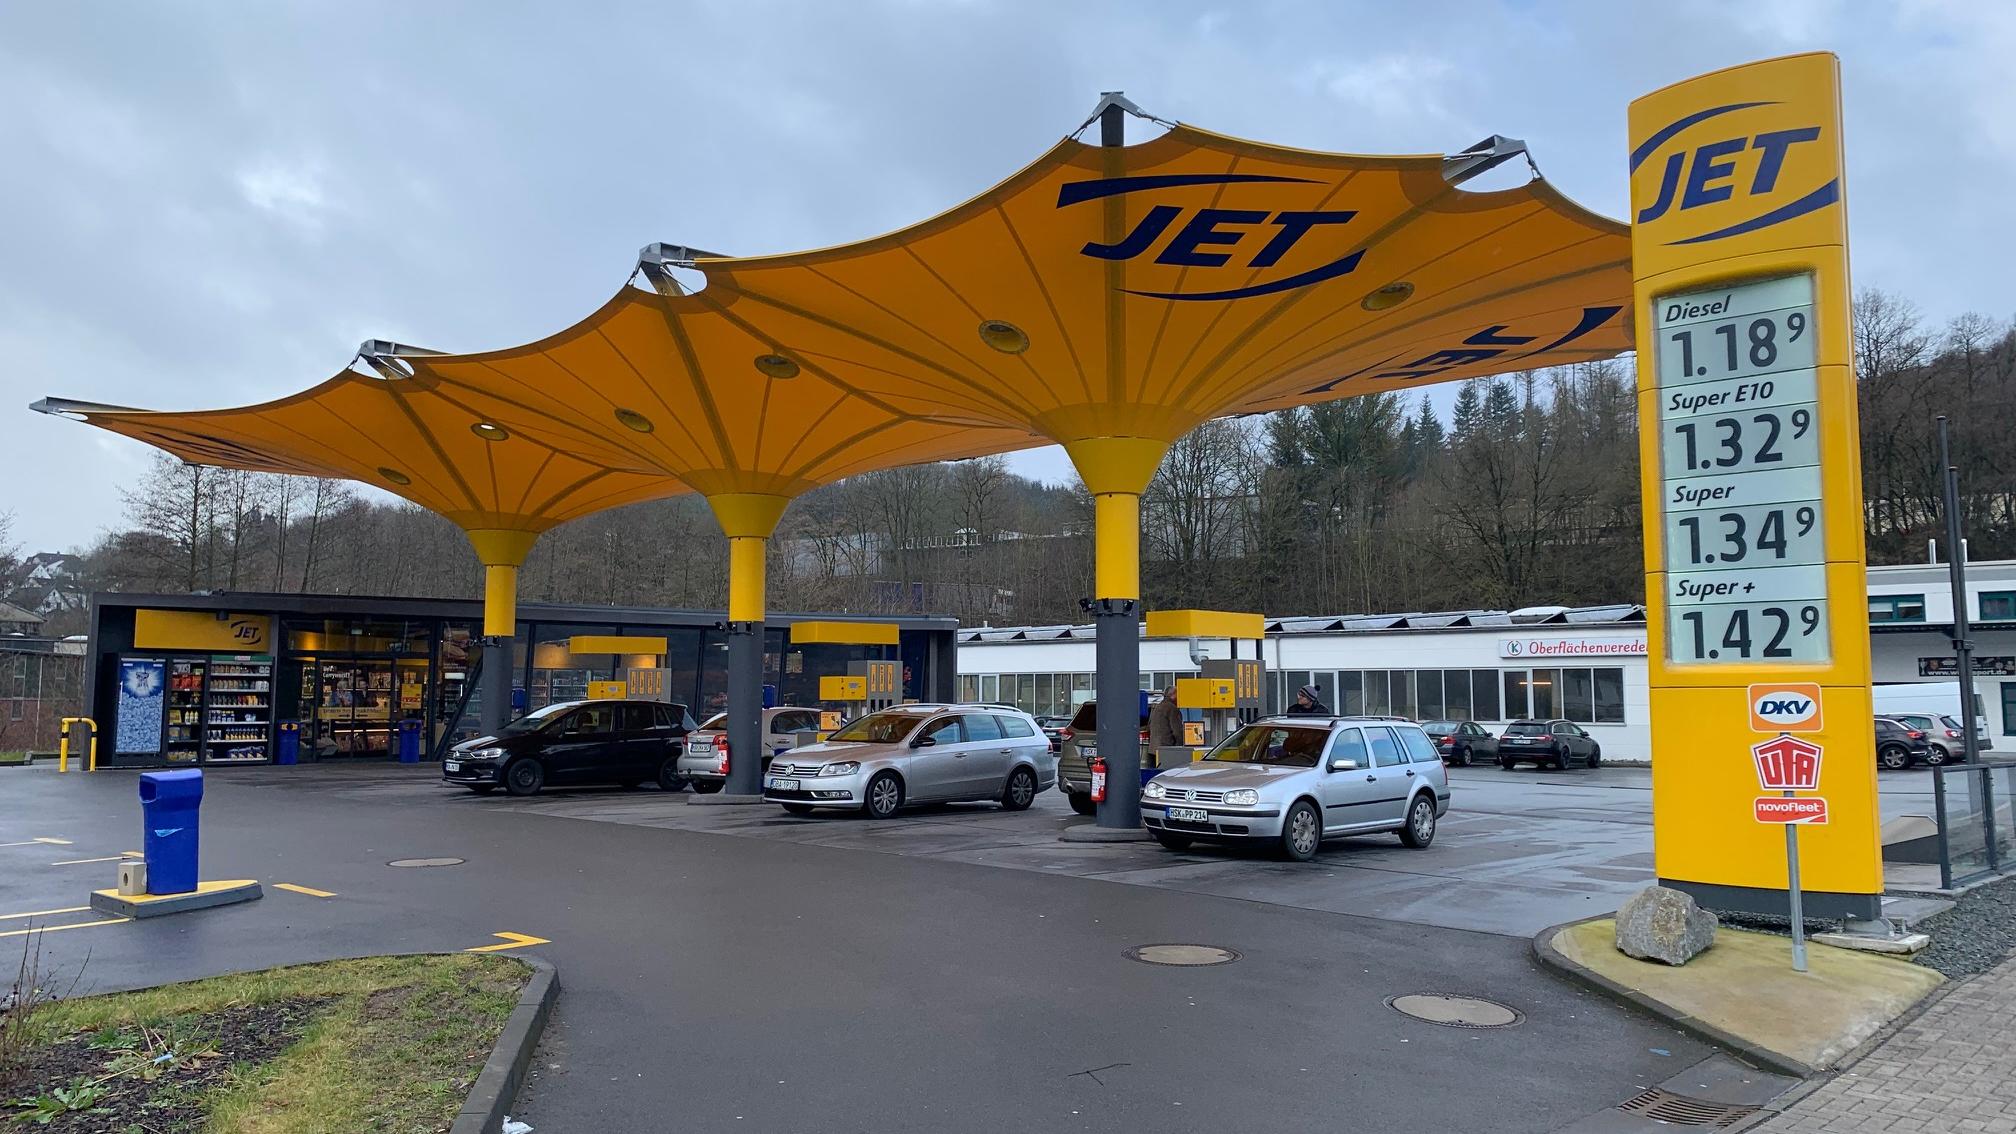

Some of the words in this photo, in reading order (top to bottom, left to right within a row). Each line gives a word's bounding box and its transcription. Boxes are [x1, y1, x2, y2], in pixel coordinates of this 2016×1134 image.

[1637, 127, 1822, 224] JET
[1080, 206, 1359, 267] JET
[1665, 295, 1731, 322] Diesel
[1669, 390, 1730, 413] Super
[1735, 381, 1775, 402] E10
[1673, 485, 1736, 507] Super
[1676, 579, 1739, 601] Super
[234, 626, 259, 639] JET
[1760, 700, 1811, 714] DKV
[1758, 740, 1817, 785] UTA
